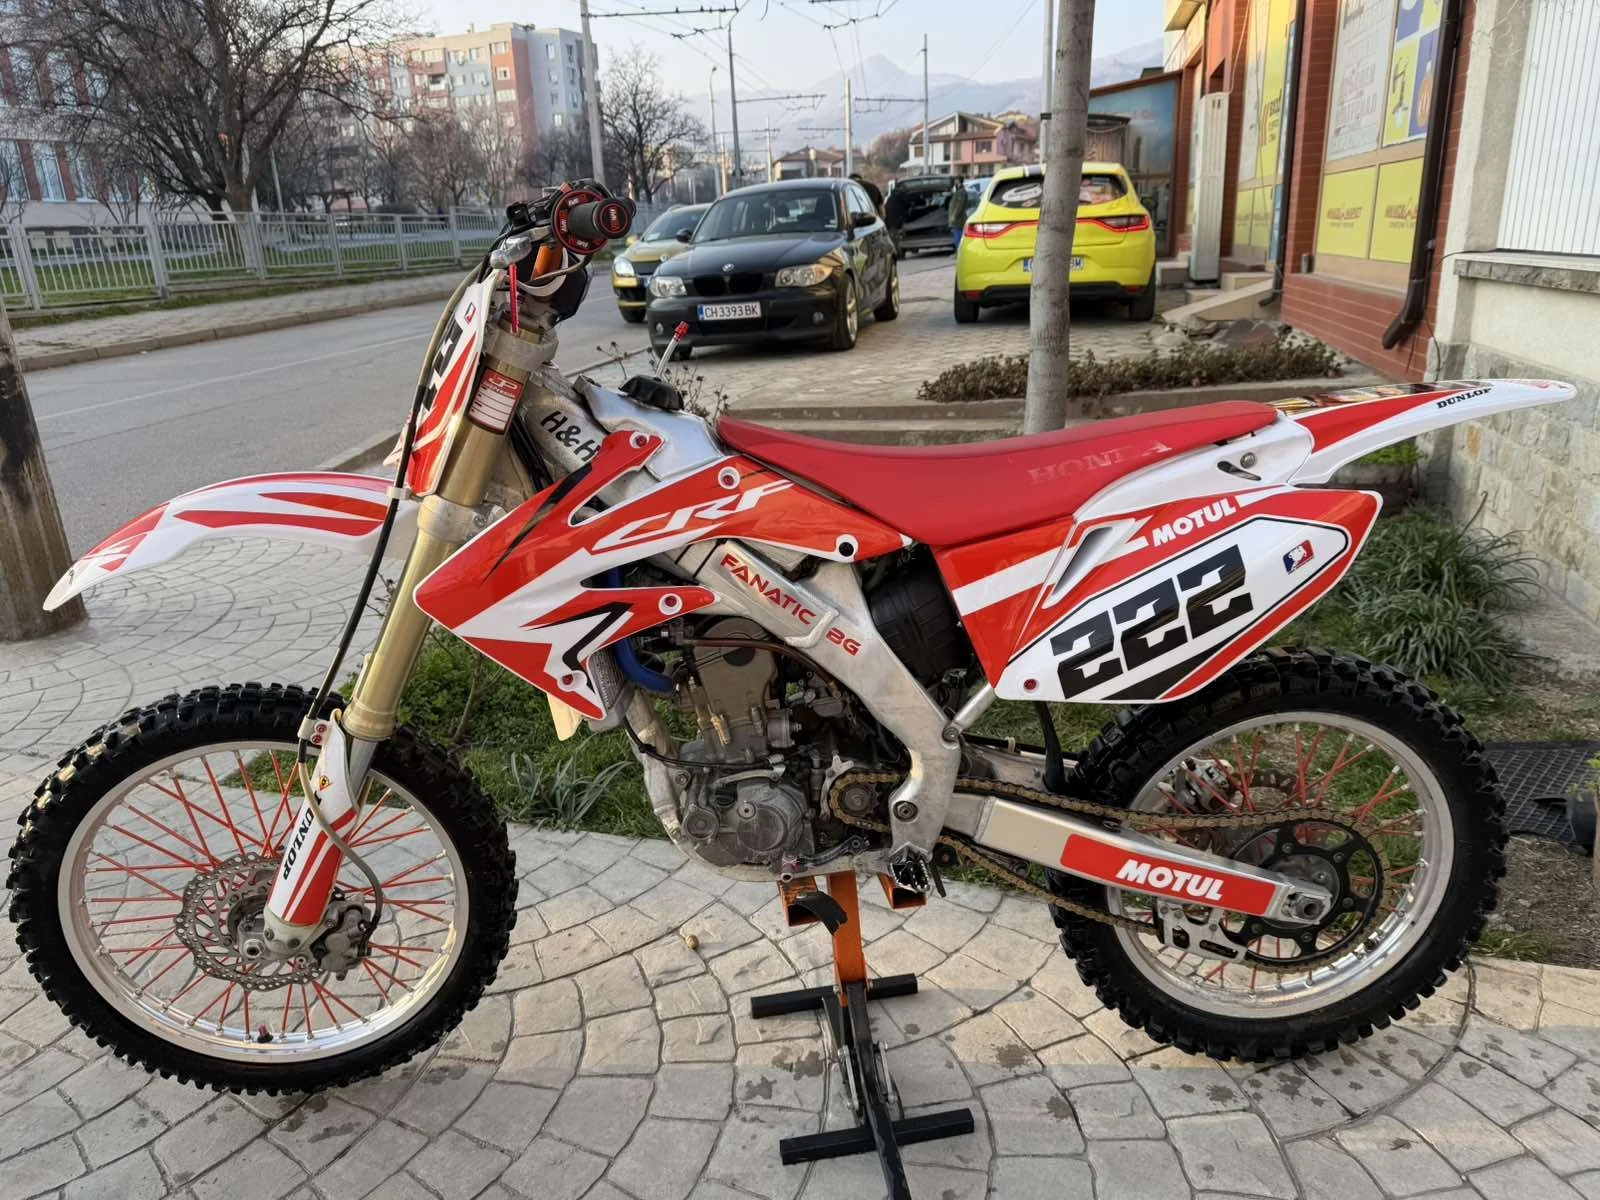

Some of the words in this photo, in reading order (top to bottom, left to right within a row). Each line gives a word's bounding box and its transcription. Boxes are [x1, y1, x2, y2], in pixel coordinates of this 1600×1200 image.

[1437, 386, 1492, 409] DUNLOP
[540, 411, 601, 462] H&H
[592, 479, 795, 551] CRF
[1153, 497, 1237, 547] MOTUL
[720, 553, 817, 625] FANATIC
[825, 627, 862, 656] BG
[1050, 543, 1254, 700] 222
[1115, 859, 1224, 900] MOTUL
